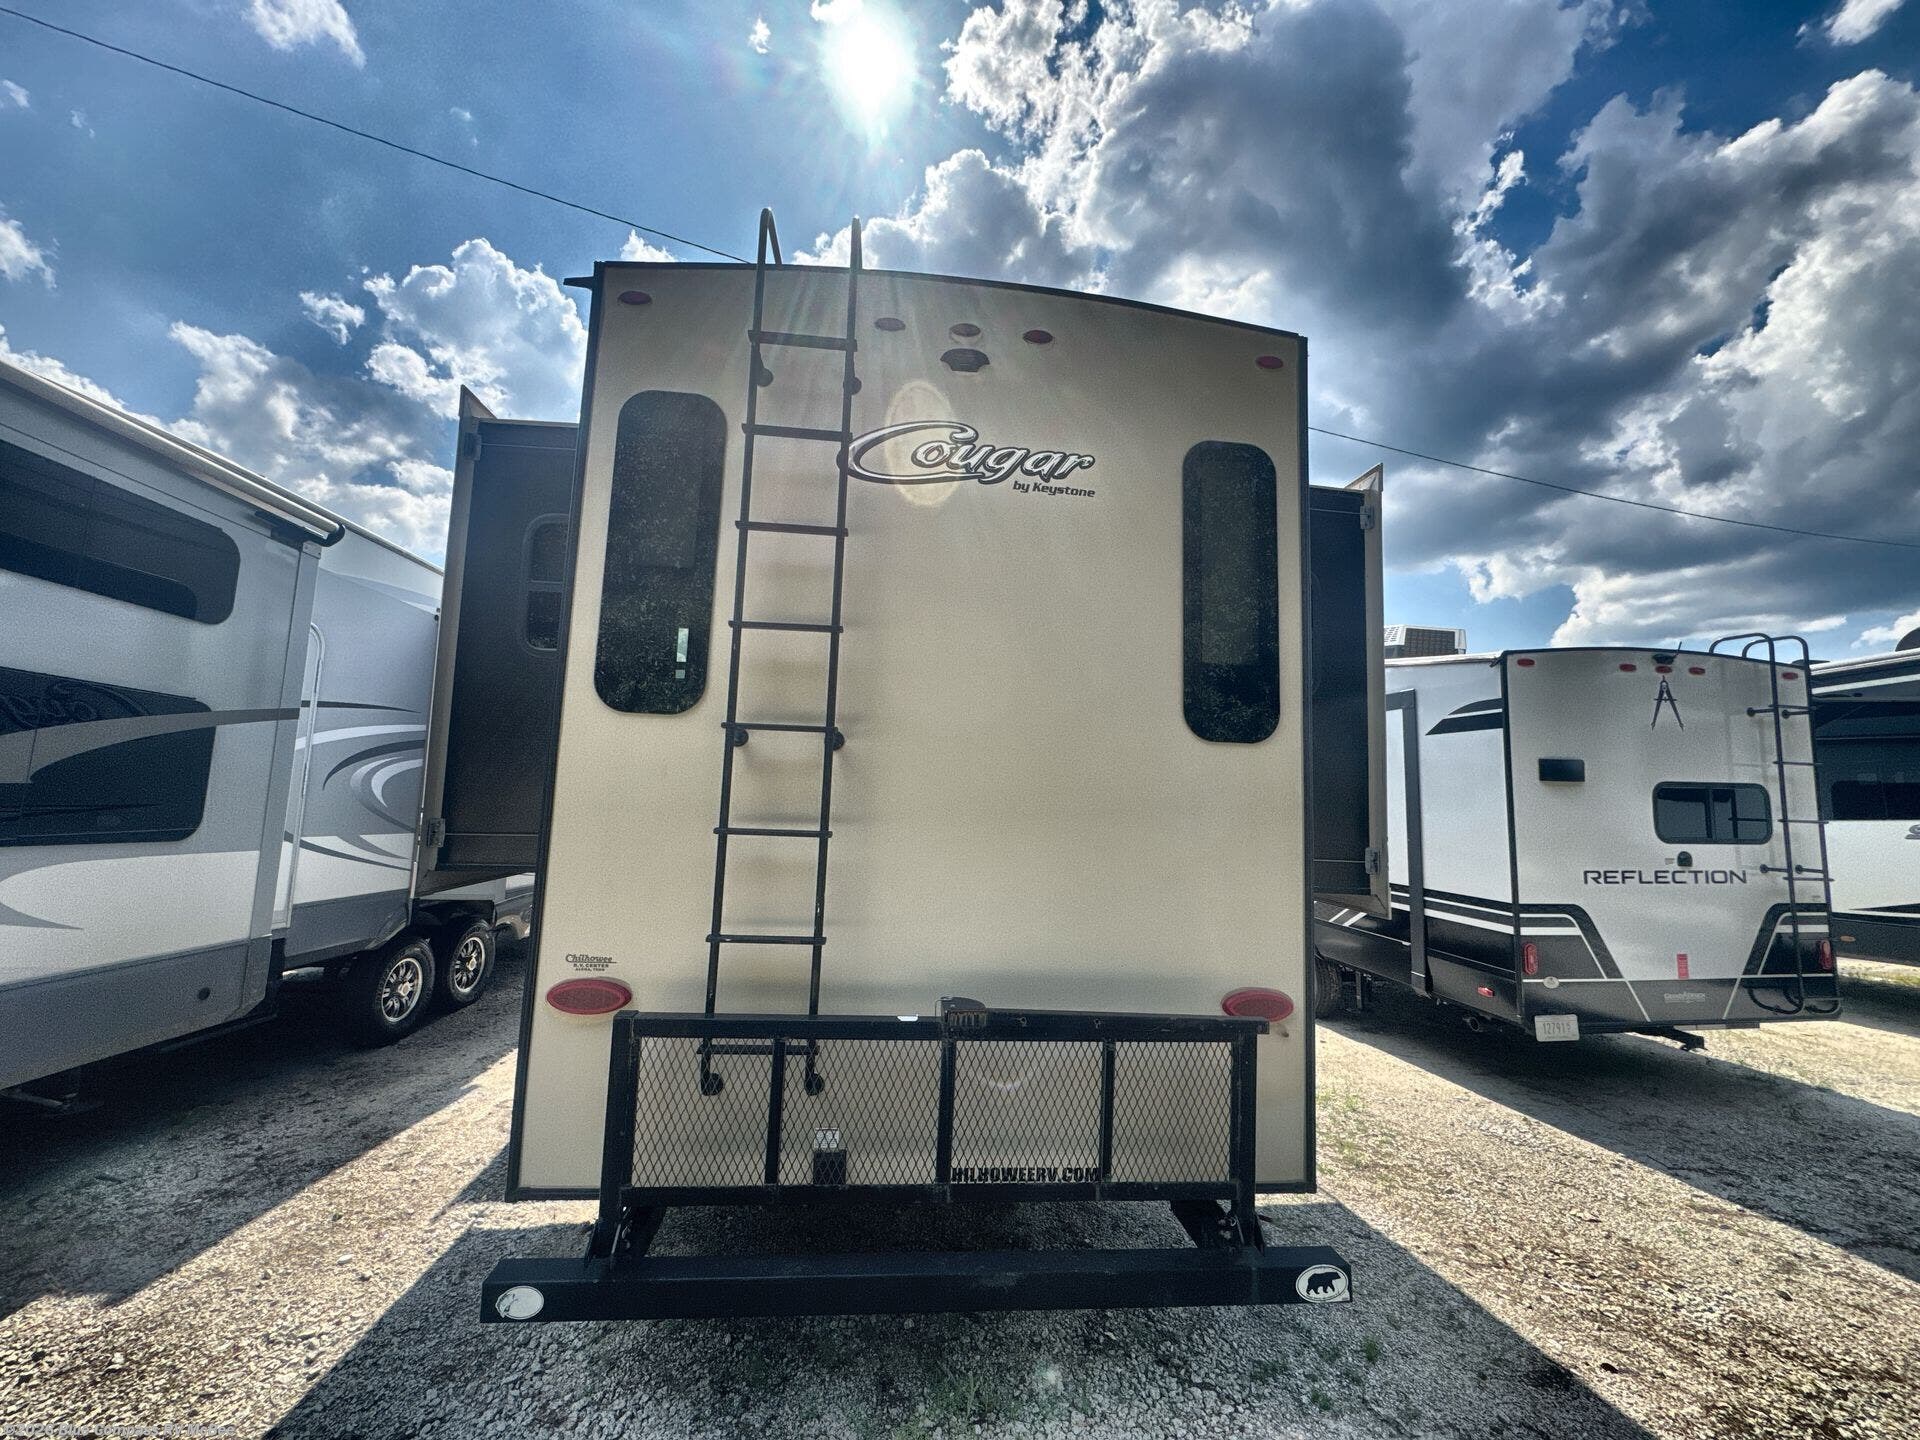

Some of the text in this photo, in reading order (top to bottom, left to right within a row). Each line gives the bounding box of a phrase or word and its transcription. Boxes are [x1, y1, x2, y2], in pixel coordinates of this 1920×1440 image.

[847, 420, 1096, 485] Cougar
[1013, 480, 1096, 498] by Keystone
[1583, 869, 1747, 885] REFLECTION
[951, 1167, 1102, 1183] HILHOWEERV.COM
